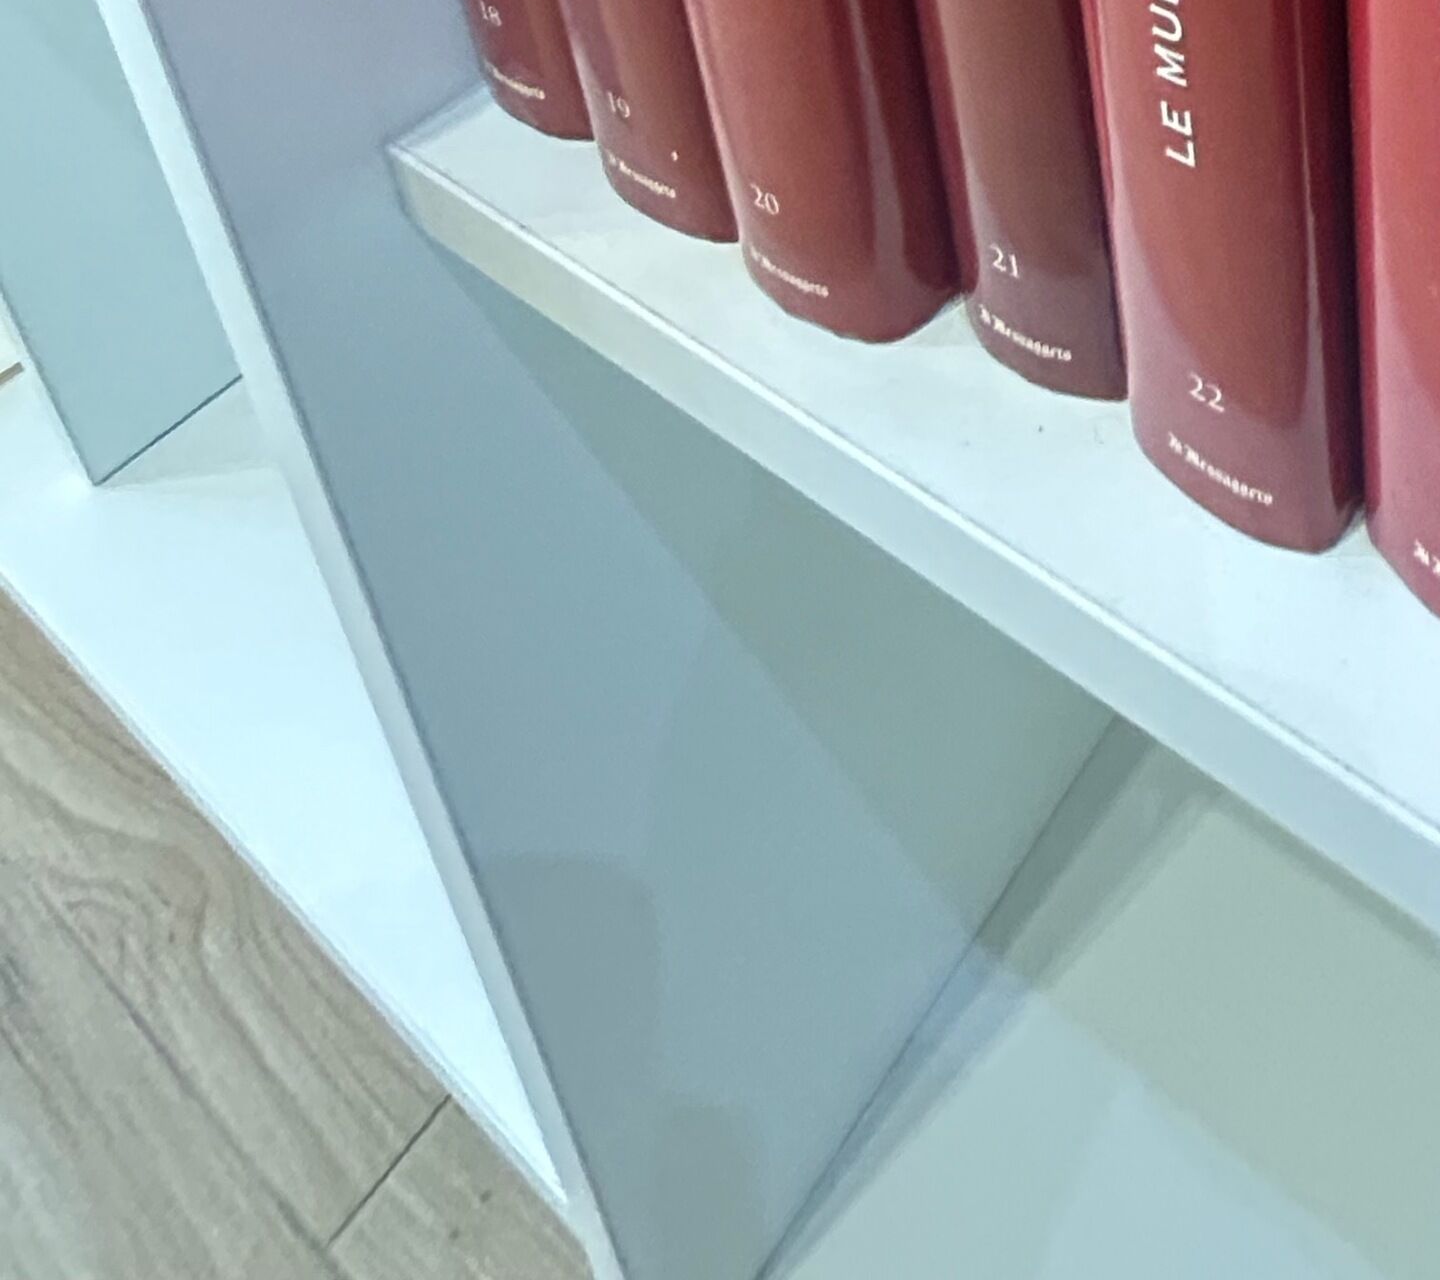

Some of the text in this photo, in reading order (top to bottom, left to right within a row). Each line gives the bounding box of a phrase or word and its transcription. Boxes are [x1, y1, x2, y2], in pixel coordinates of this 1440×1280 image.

[479, 0, 502, 27] 18
[607, 91, 630, 118] 19
[1160, 101, 1196, 168] LE
[750, 183, 780, 216] 20
[989, 242, 1019, 279] 21
[1187, 372, 1225, 413] 22
